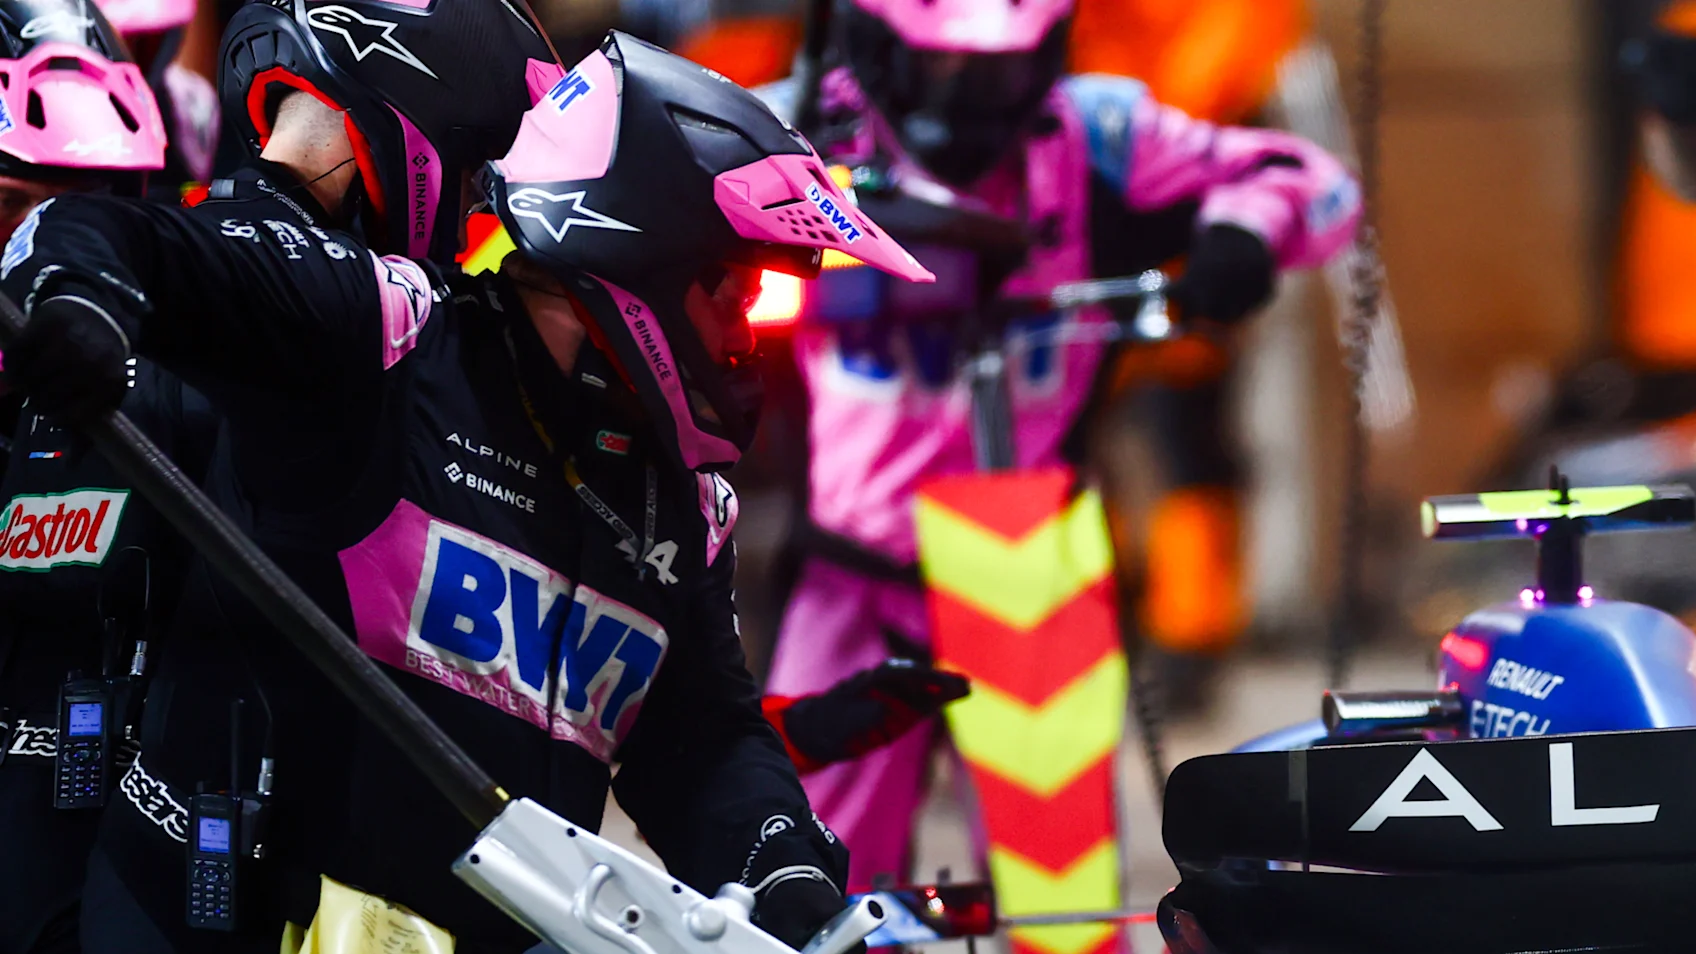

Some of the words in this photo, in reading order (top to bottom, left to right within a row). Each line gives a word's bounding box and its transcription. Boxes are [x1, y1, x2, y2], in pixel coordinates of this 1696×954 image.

[548, 69, 592, 113] WT
[413, 172, 427, 241] BINANCE
[818, 199, 862, 243] BWT
[634, 319, 673, 381] BINANCE
[446, 432, 538, 478] ALPINE
[465, 472, 536, 514] BINANCE
[0, 498, 112, 560] Castrol
[419, 535, 664, 732] BWT
[1487, 657, 1566, 701] RENAULT
